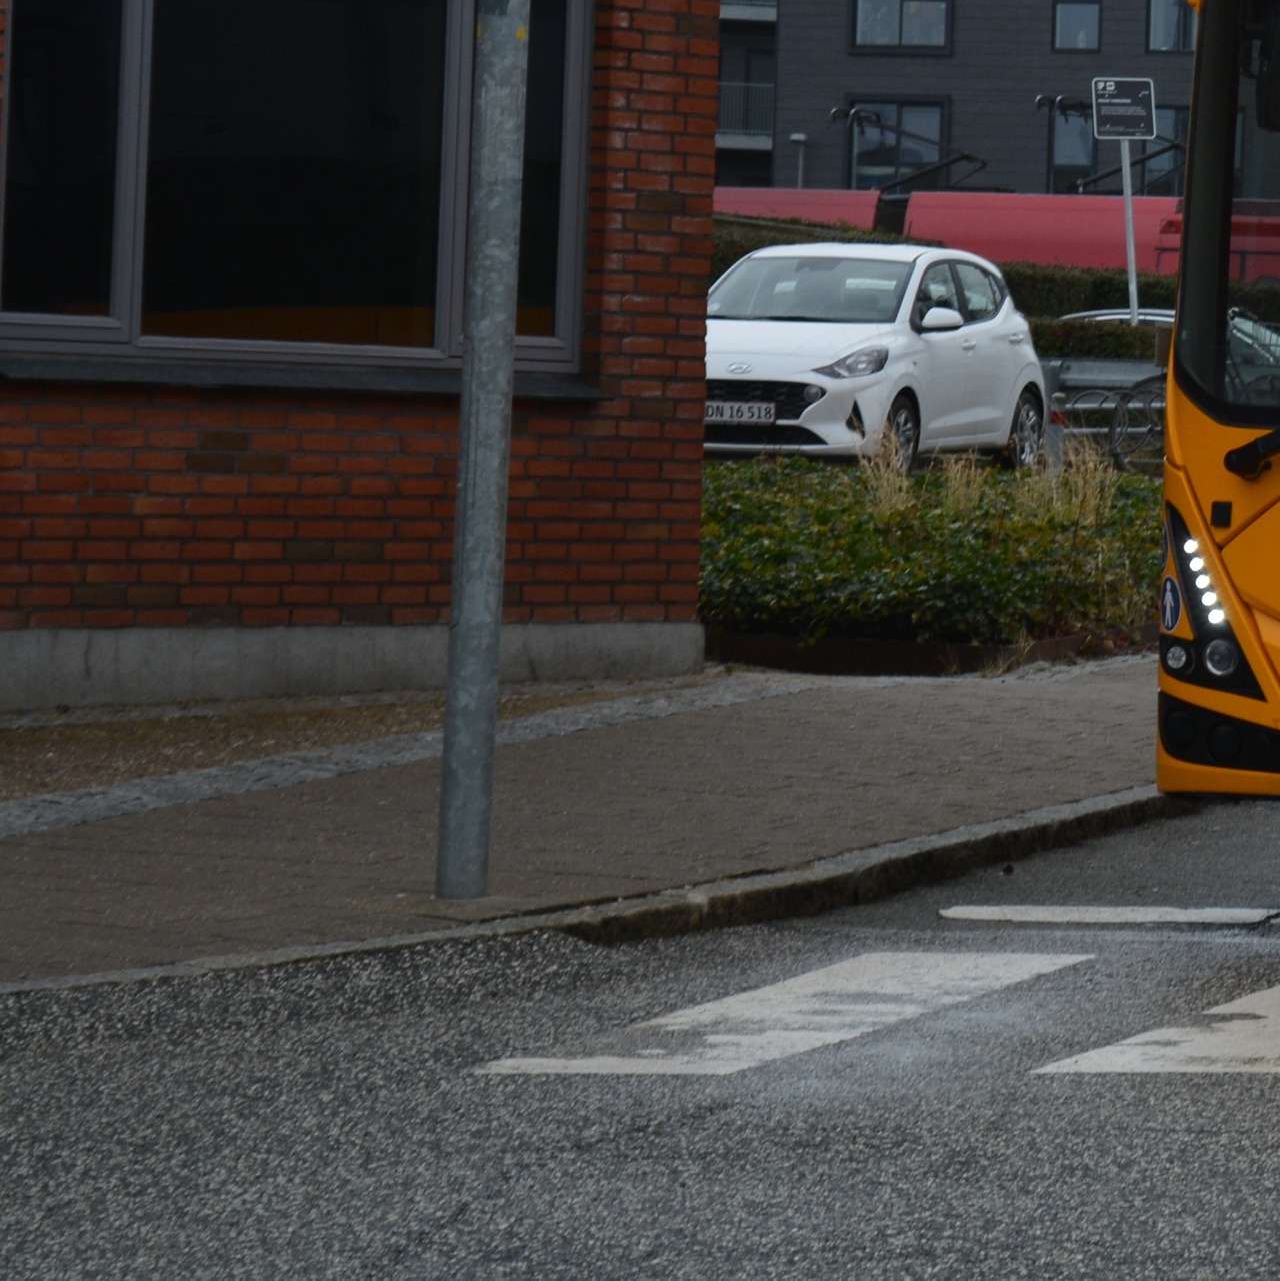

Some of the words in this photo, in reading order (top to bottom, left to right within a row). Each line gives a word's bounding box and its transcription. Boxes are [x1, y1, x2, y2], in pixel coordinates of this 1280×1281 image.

[705, 405, 724, 418] DN
[728, 405, 744, 419] 16
[747, 406, 772, 419] 518
